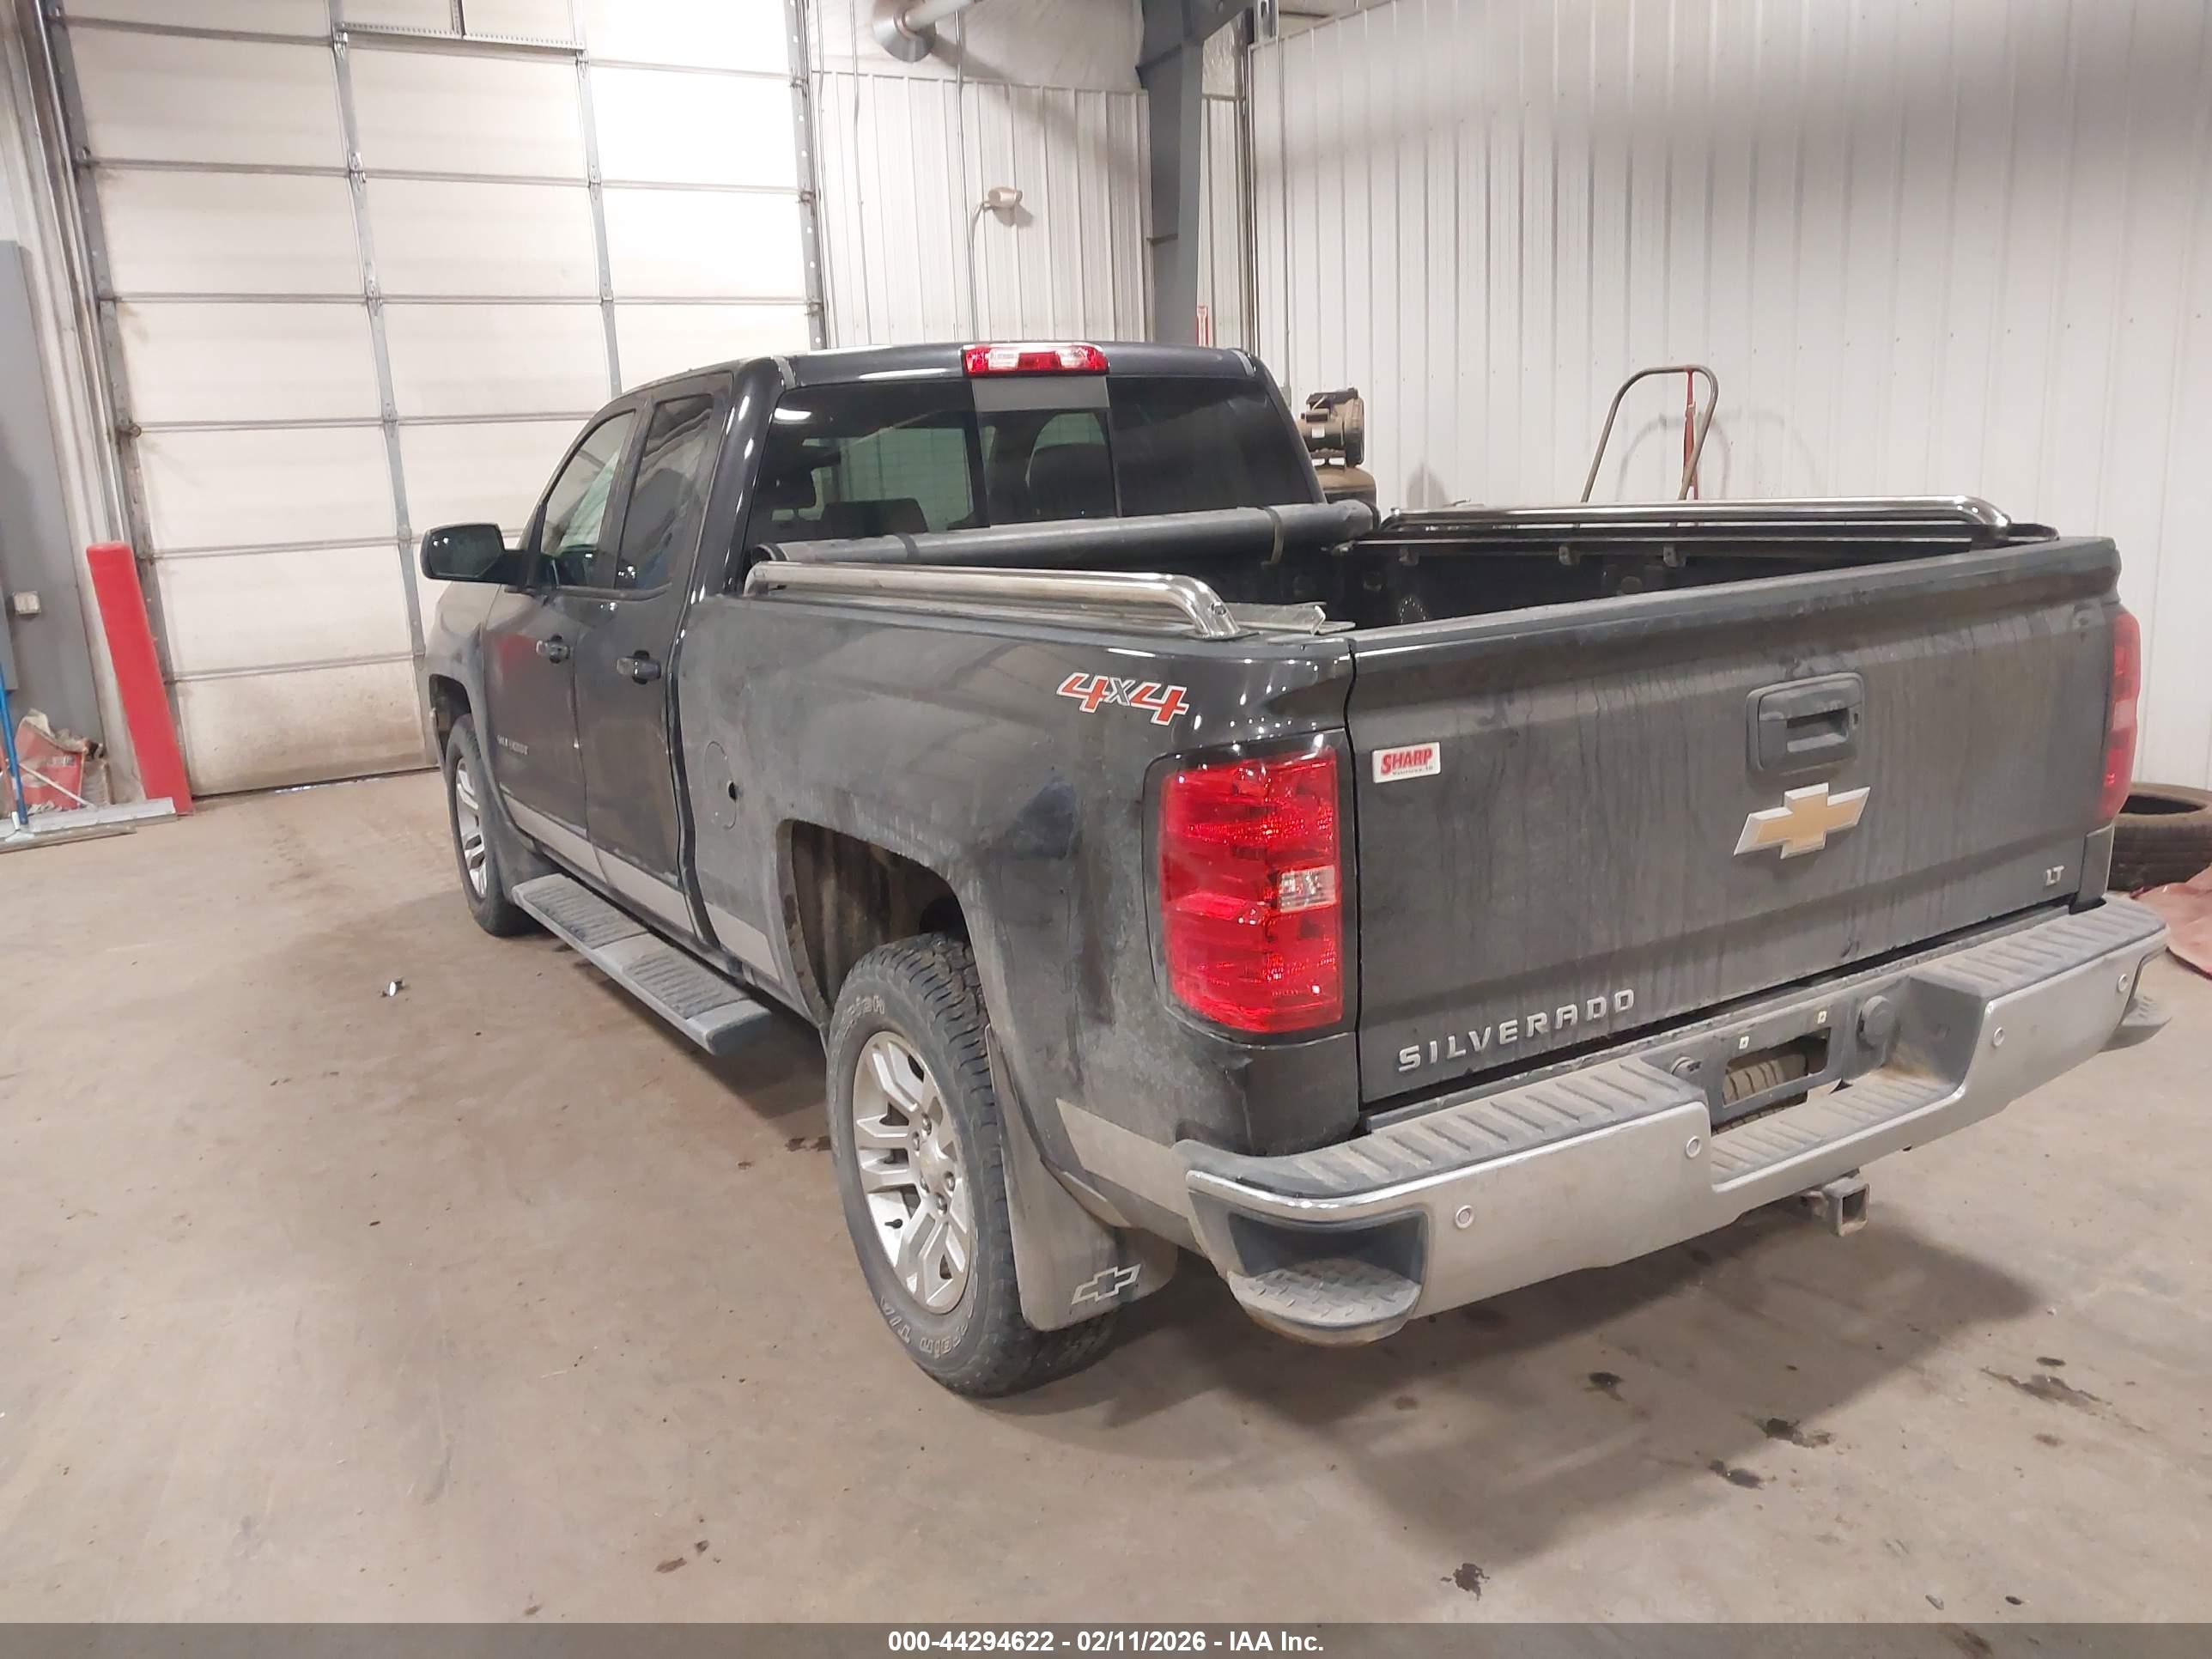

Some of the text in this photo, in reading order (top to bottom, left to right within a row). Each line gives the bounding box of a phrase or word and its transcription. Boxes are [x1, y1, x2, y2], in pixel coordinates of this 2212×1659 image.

[1381, 748, 1432, 775] SHARP
[2045, 865, 2065, 886] LT
[1398, 988, 1635, 1073] SILVERADO
